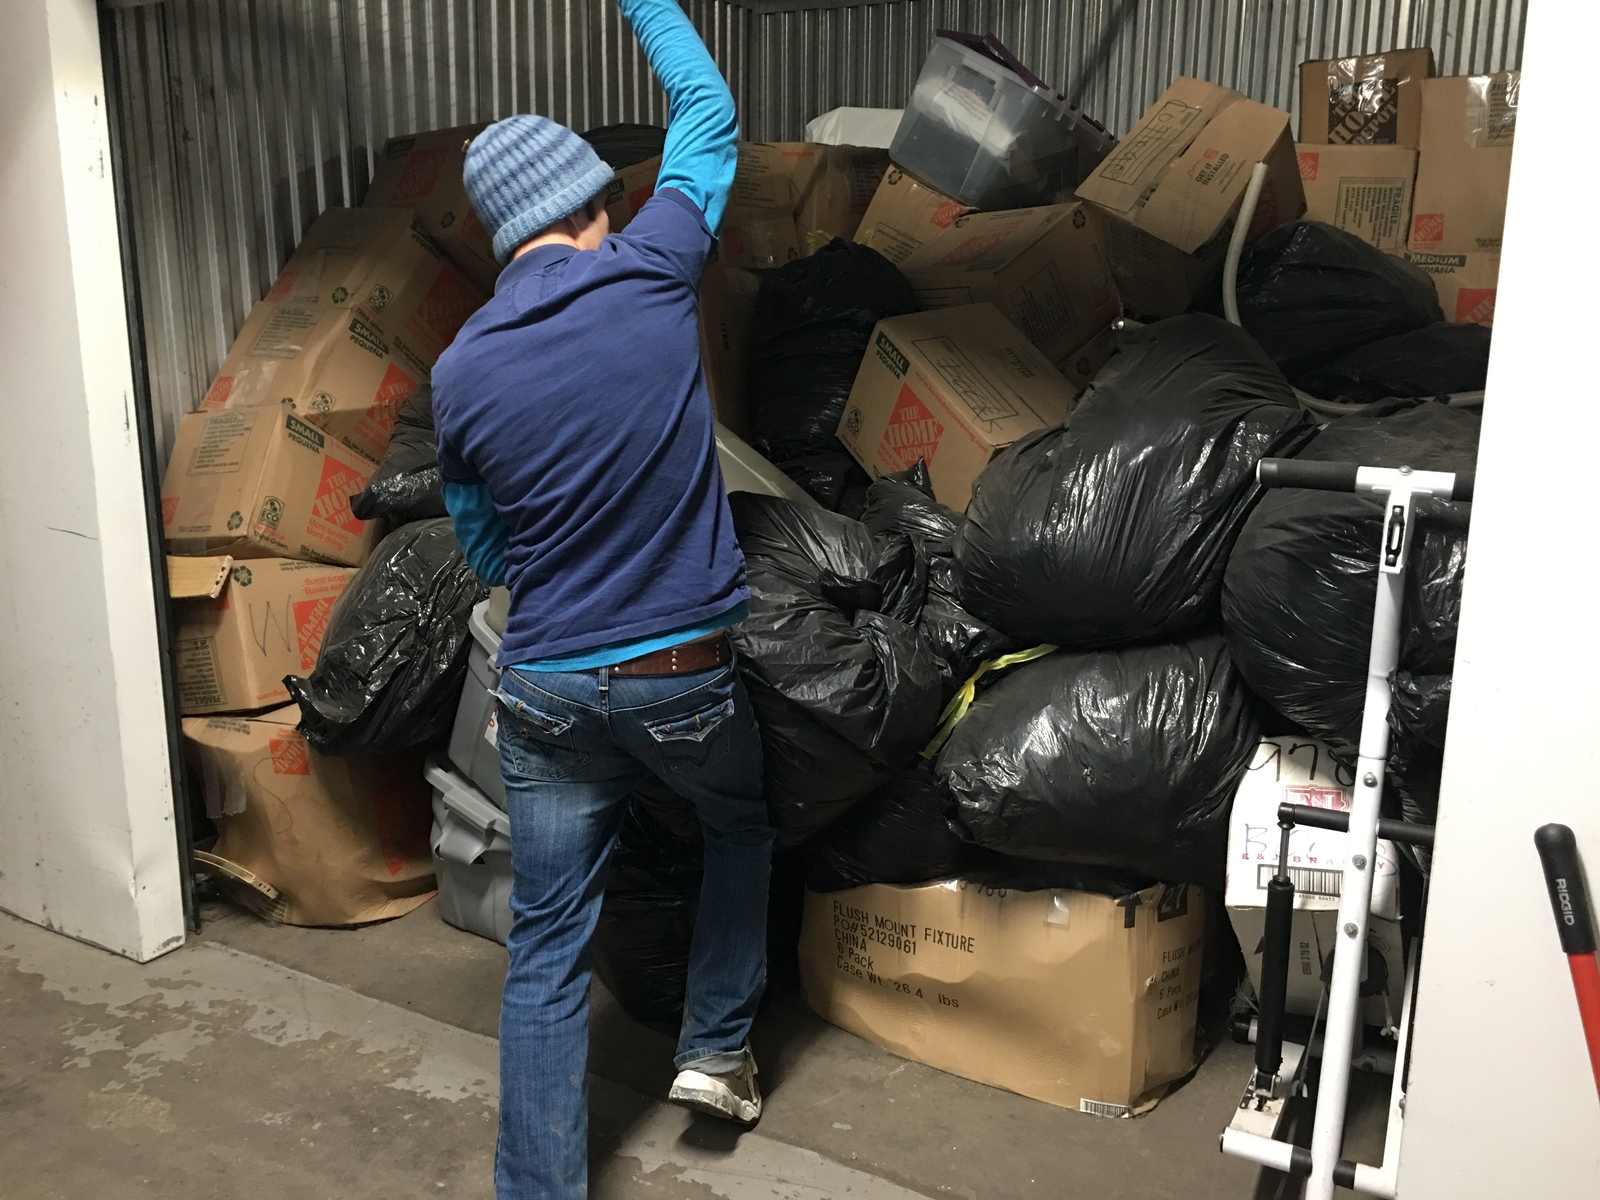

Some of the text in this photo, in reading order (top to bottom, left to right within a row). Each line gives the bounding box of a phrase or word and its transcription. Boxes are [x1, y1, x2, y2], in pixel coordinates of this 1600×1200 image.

[1195, 169, 1207, 182] GET
[1201, 153, 1229, 185] INSTALLED
[1390, 187, 1402, 224] FRAGILE
[1410, 255, 1459, 264] MEDIUM
[354, 323, 387, 351] SMALL
[880, 337, 904, 369] SMALL
[312, 402, 331, 413] ECO
[899, 406, 920, 421] THE
[290, 420, 320, 444] SMALL
[887, 418, 941, 447] HOME
[900, 444, 934, 461] DEPOT
[327, 470, 347, 488] THE
[261, 510, 279, 523] ECO
[310, 518, 326, 531] More
[306, 527, 323, 540] More
[270, 538, 288, 551] Green.
[297, 598, 328, 644] DEPOT
[1161, 882, 1187, 914] 27
[1555, 878, 1574, 926] RIDGID
[833, 900, 975, 953] FLUSH MOUNT FIXTURE
[833, 915, 917, 955] PO#52129061
[834, 928, 867, 952] CHINA
[837, 942, 874, 971] 6 Pack
[1162, 945, 1185, 964] FLUSH
[836, 955, 863, 979] Case
[938, 993, 960, 1008] lbs
[1161, 966, 1180, 983] CHINA
[1159, 984, 1182, 1000] 6 Pack
[1157, 1004, 1172, 1020] Case
